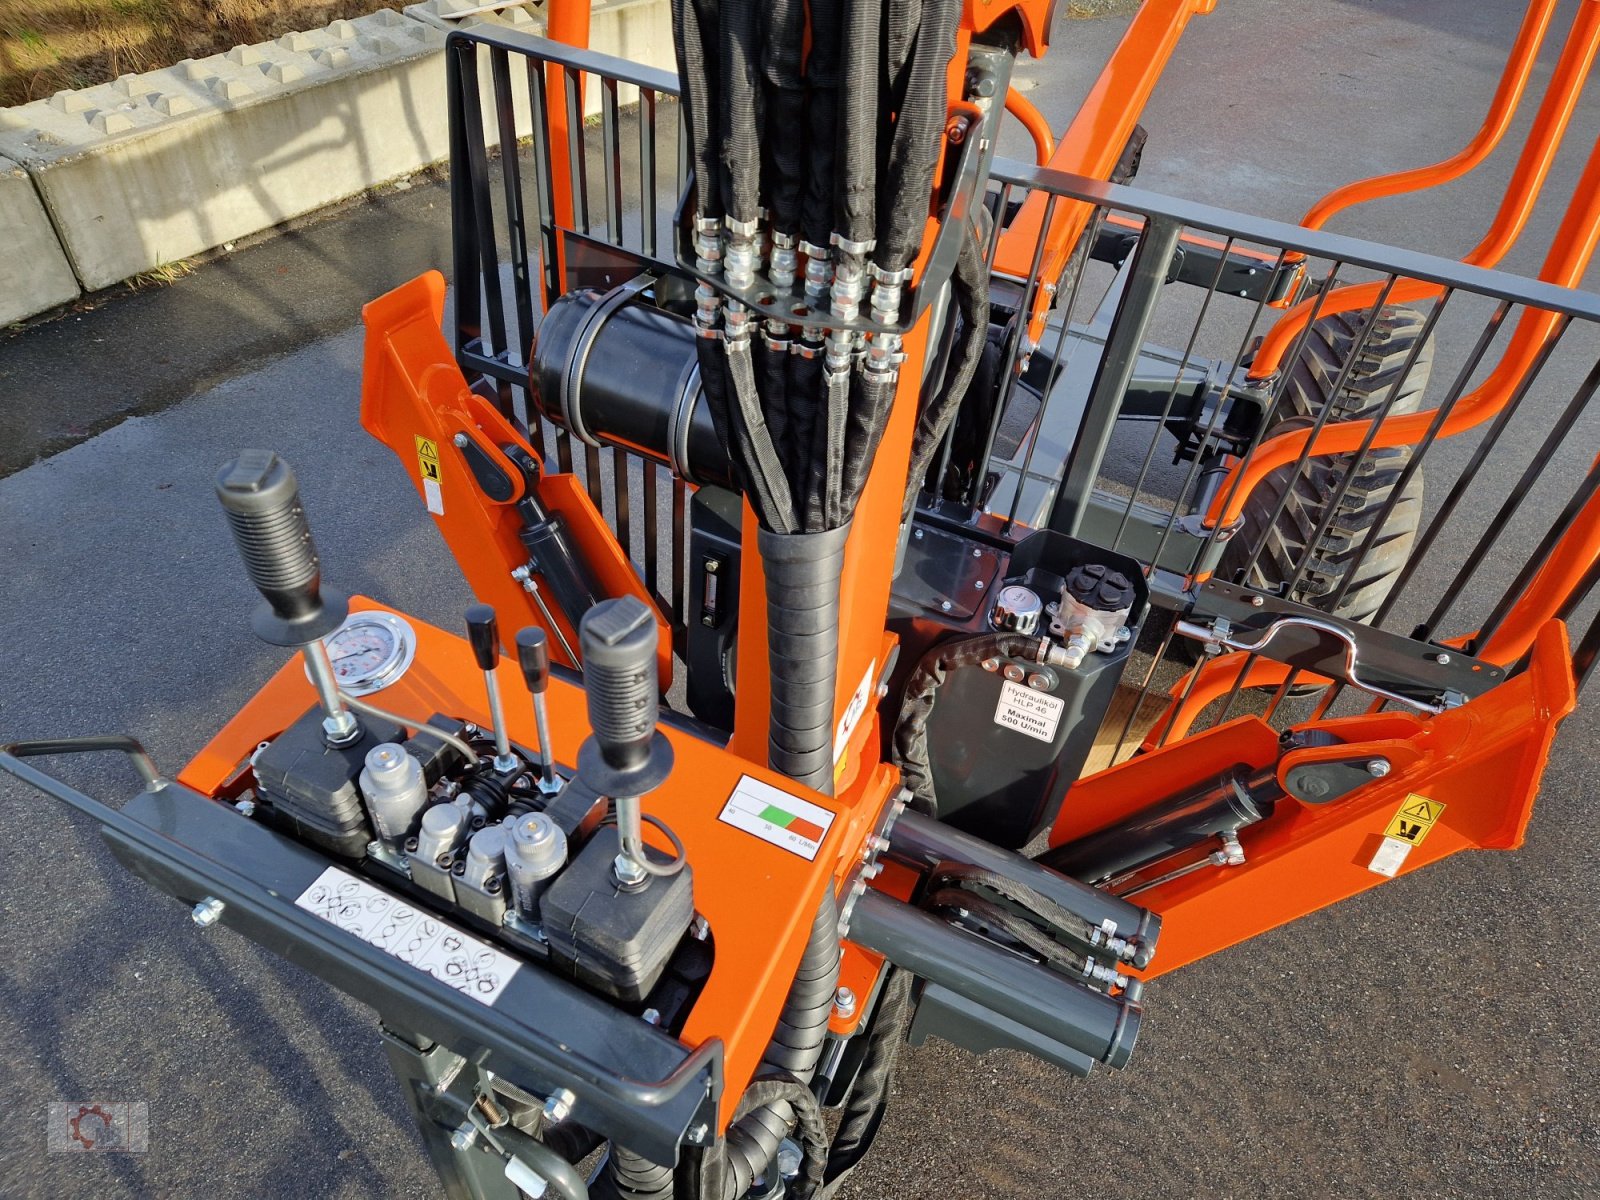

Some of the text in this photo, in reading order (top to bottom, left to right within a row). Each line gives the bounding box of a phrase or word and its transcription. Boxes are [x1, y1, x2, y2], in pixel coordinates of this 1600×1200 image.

[1008, 687, 1058, 709] Hydrauliköl
[1013, 697, 1047, 714] HLP 46
[1001, 715, 1048, 737] 500 U/min
[1007, 709, 1046, 727] Maximal
